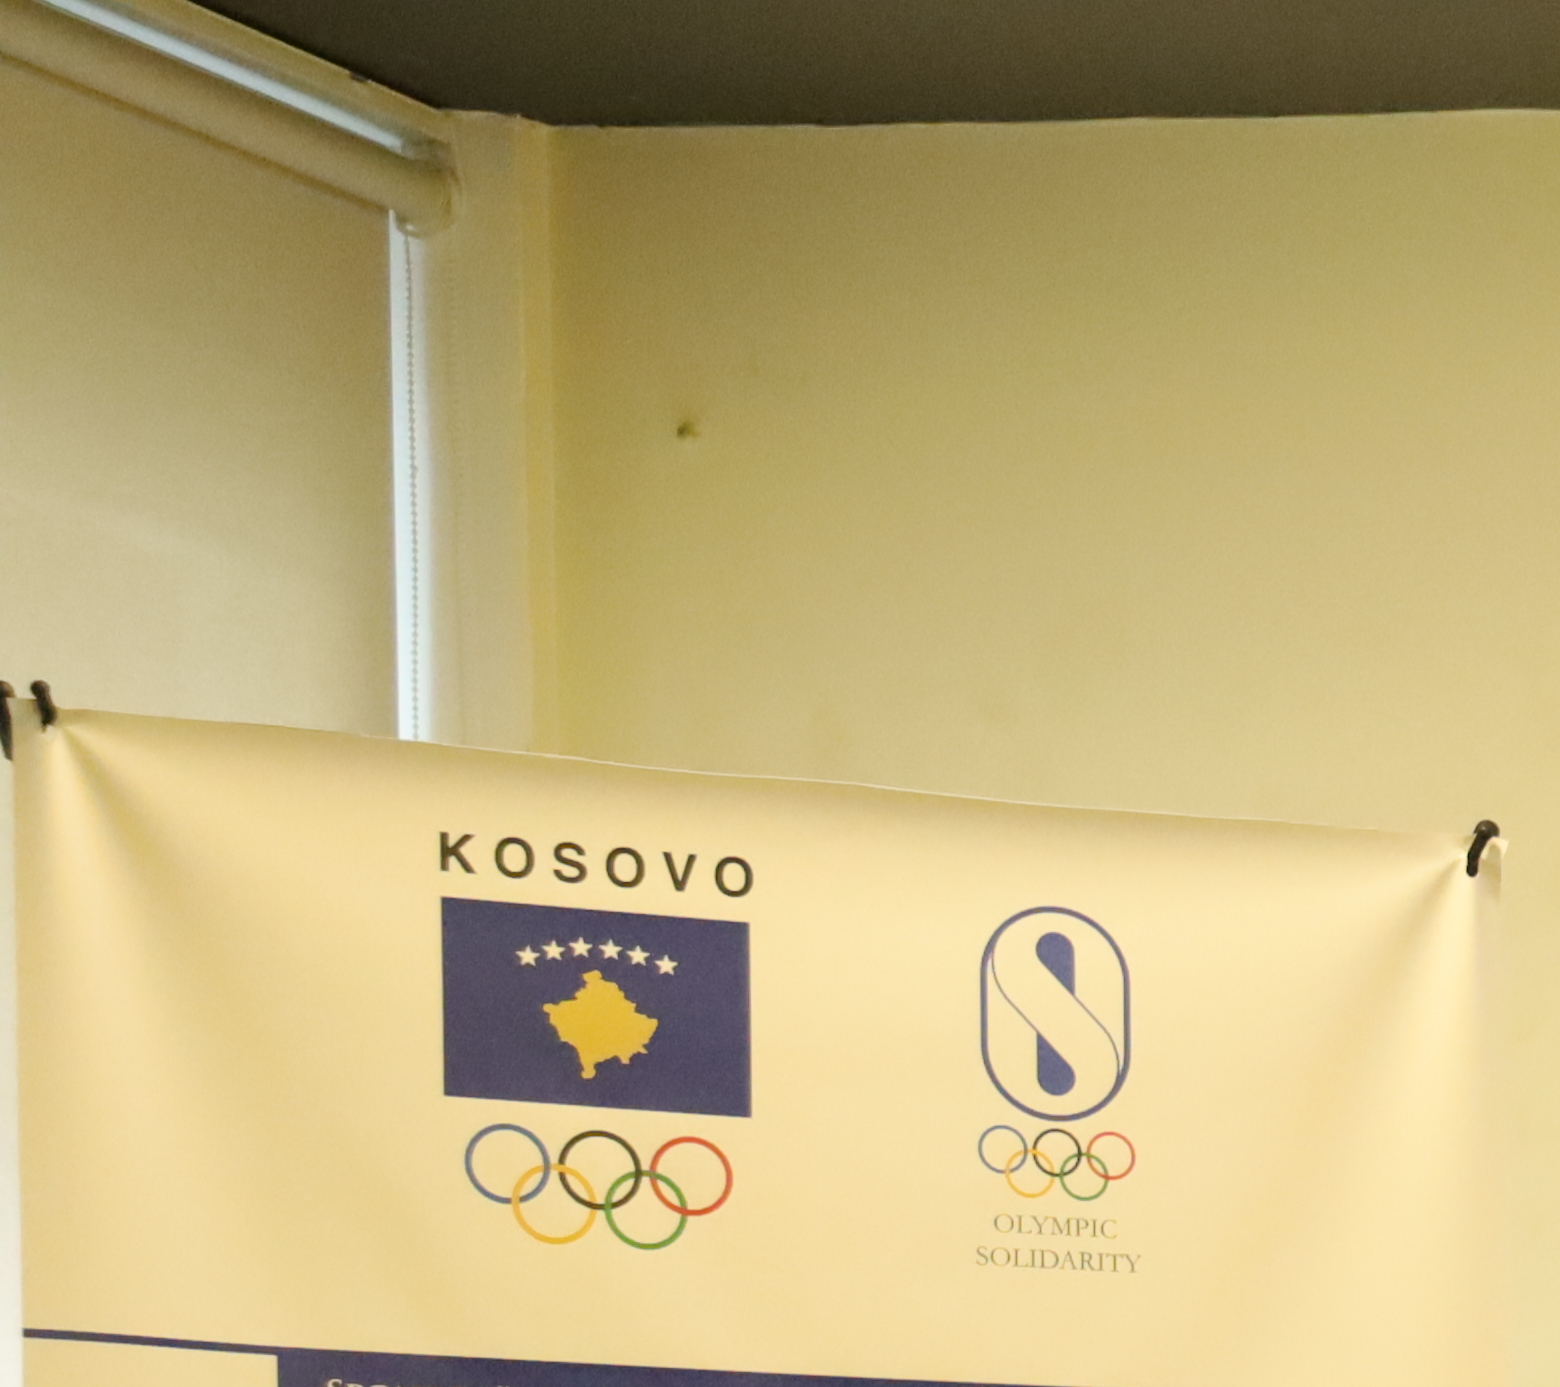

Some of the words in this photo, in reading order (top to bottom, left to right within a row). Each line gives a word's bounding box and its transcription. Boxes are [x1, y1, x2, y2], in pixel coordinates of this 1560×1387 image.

[439, 831, 755, 898] KOSOVO
[994, 1213, 1118, 1240] OLYMPIC
[976, 1245, 1142, 1274] SOLIDARITY
